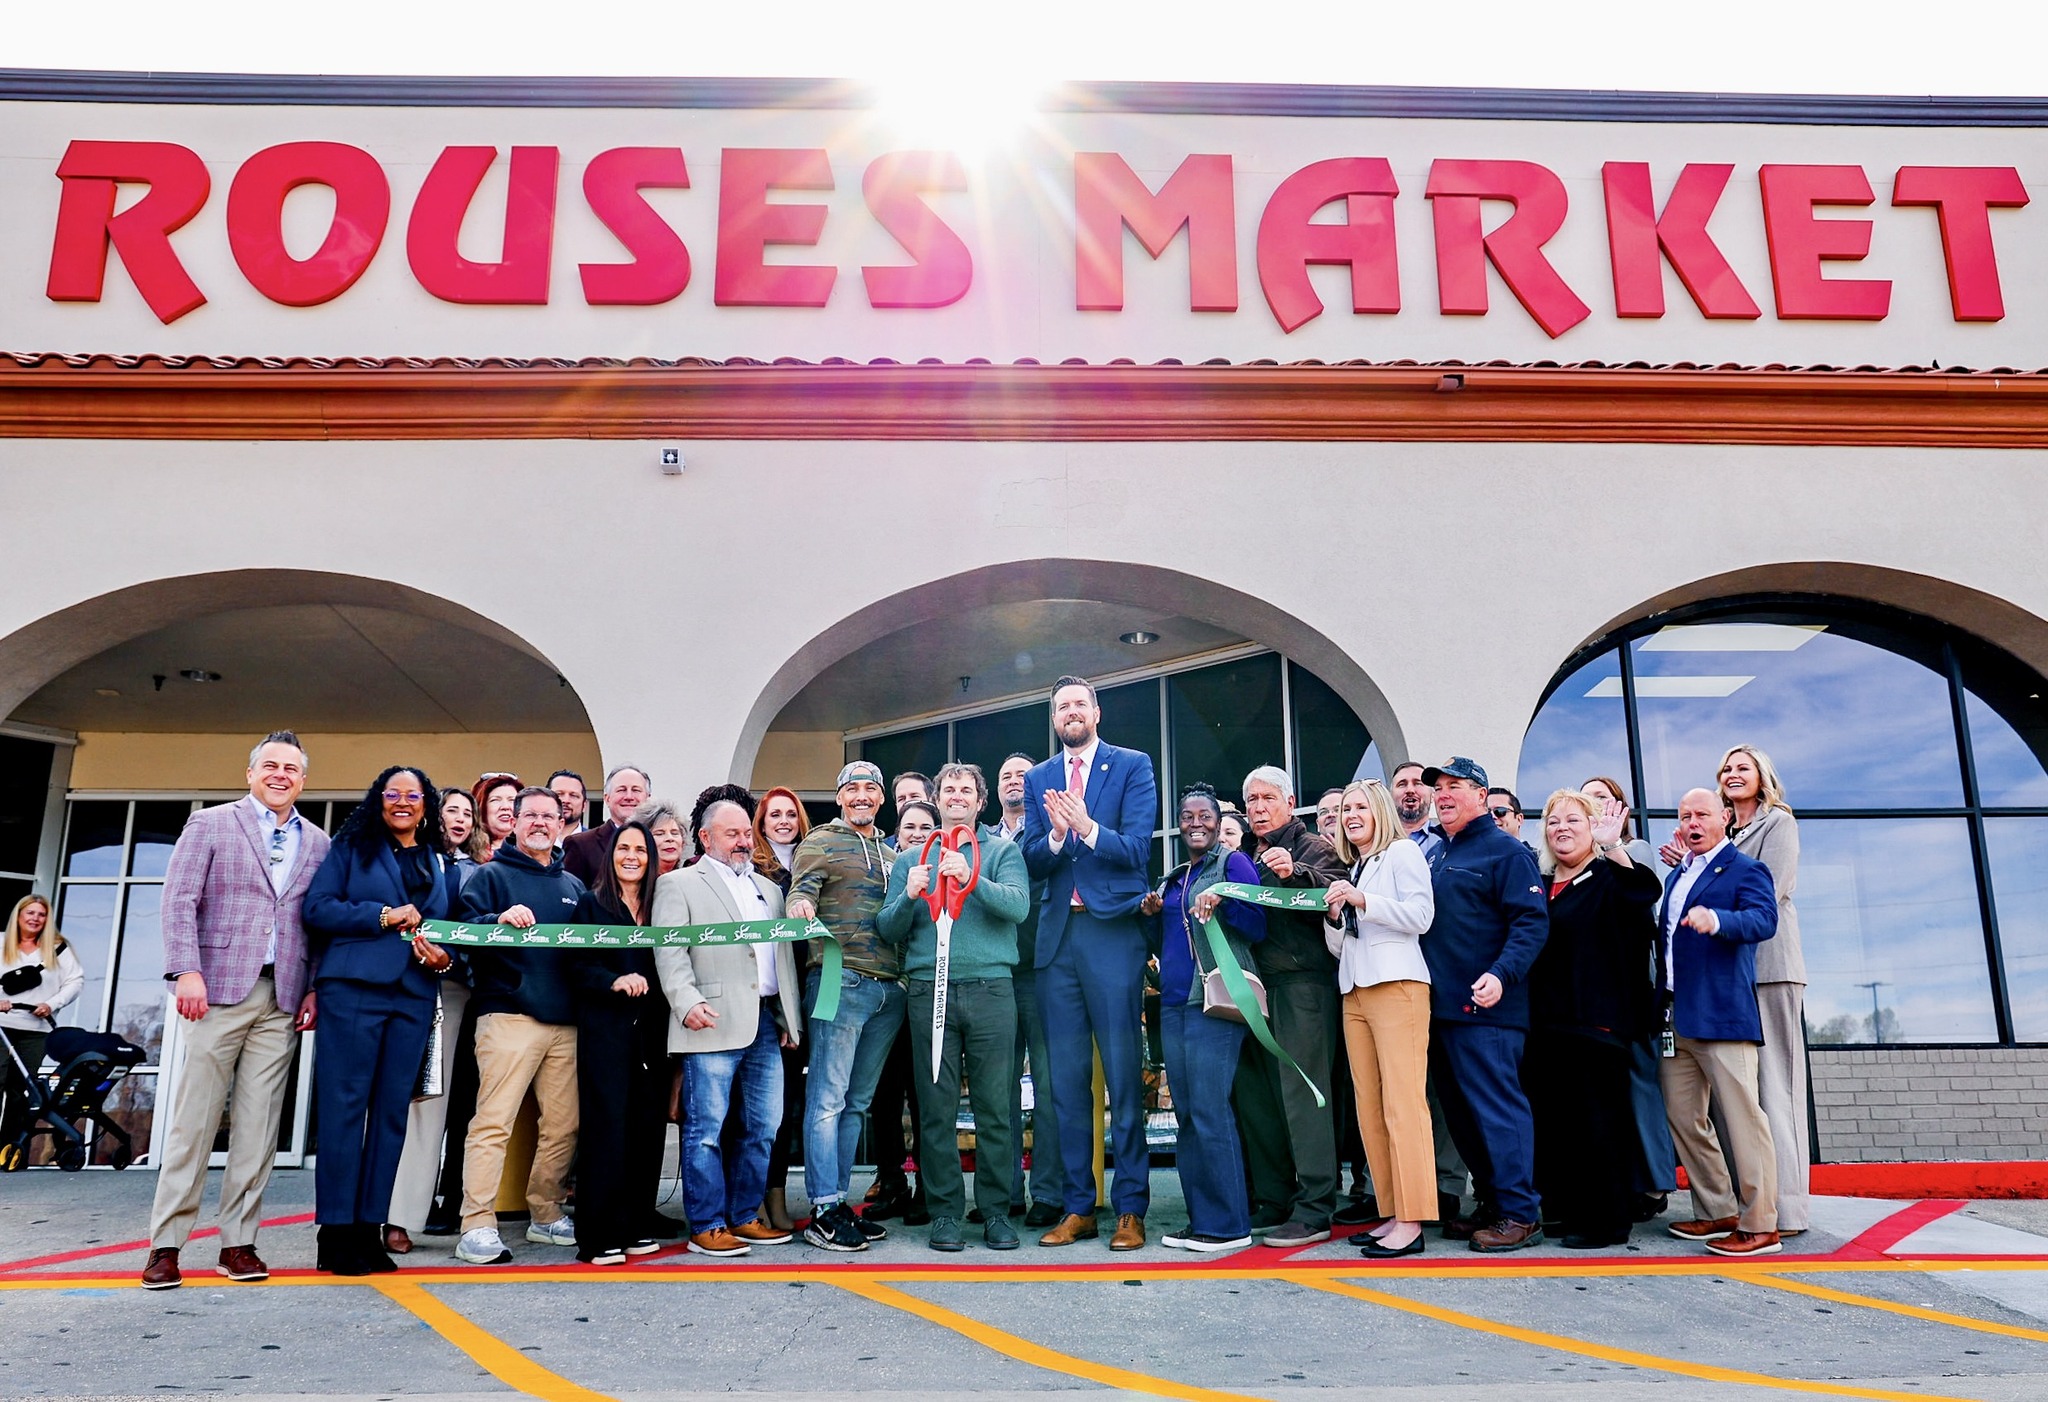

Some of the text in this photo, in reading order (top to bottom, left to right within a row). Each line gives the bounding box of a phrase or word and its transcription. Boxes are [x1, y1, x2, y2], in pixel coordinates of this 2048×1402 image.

[46, 140, 2030, 339] ROUSES MARKET
[935, 956, 946, 1030] ROUSES MARKETS
